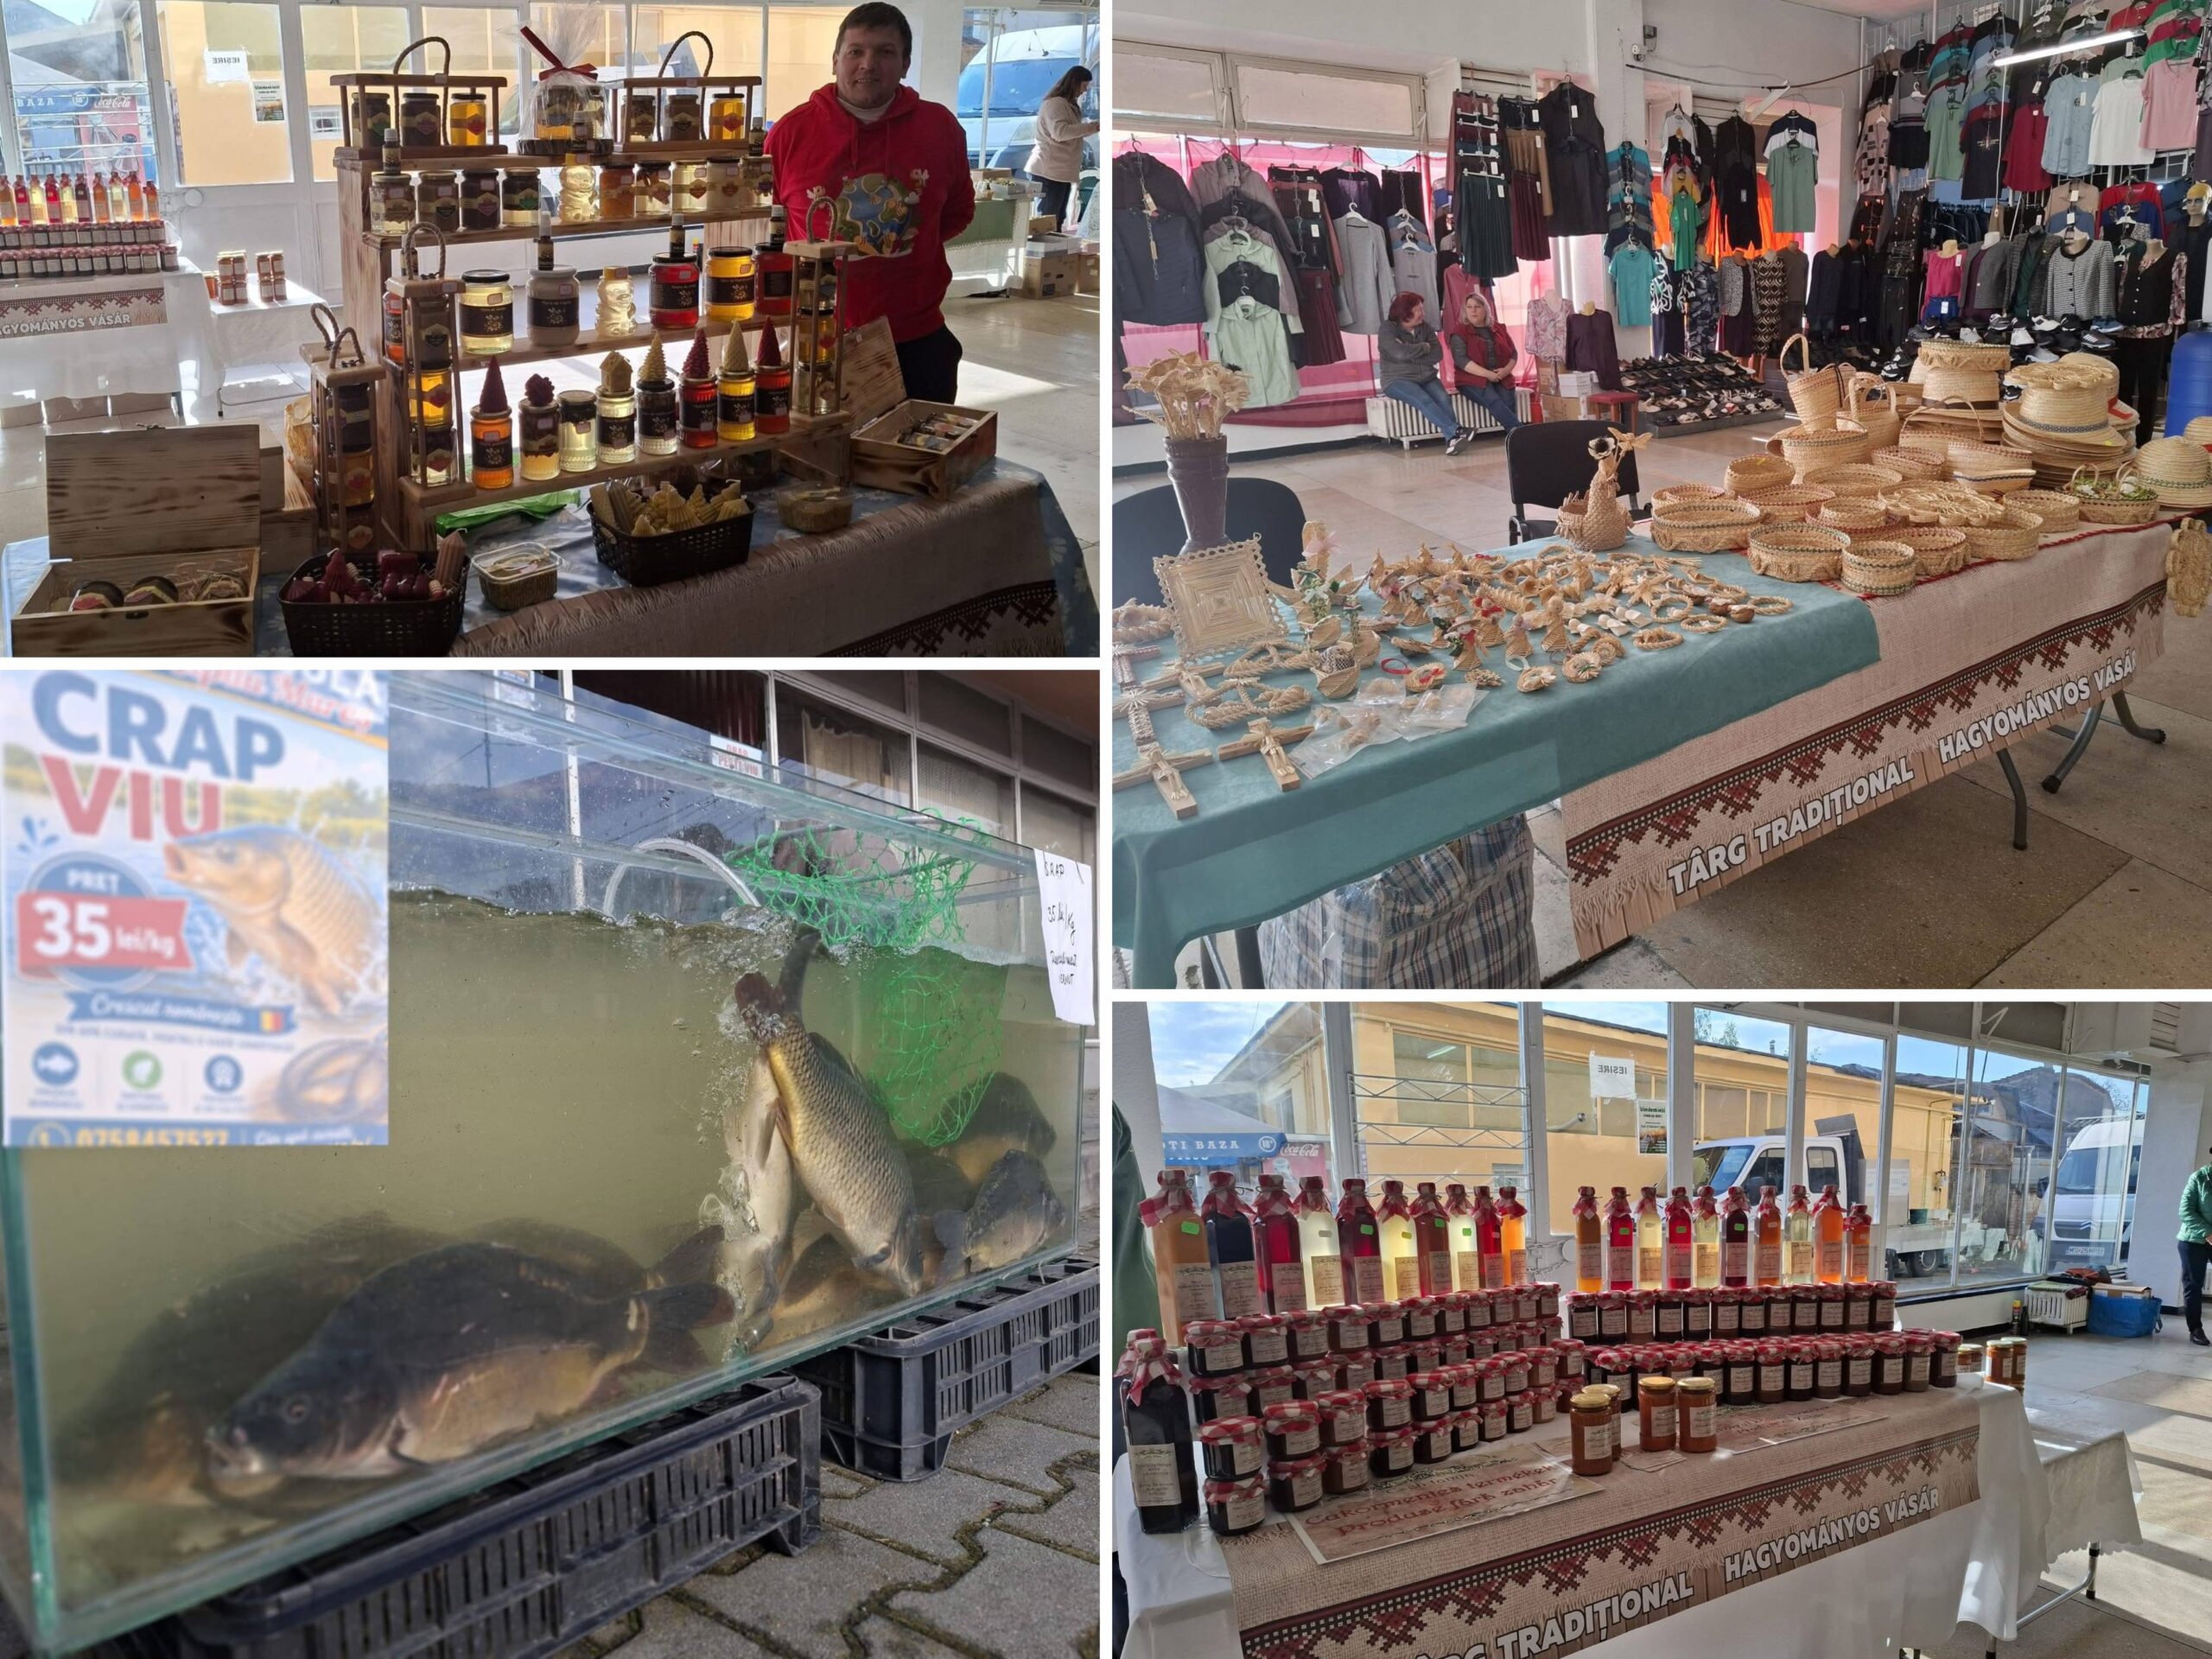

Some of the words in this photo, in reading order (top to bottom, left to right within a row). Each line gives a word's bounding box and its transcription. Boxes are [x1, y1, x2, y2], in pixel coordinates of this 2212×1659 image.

[89, 311, 130, 327] VÁSÁR
[33, 670, 284, 781] CRAP
[41, 753, 221, 842] VIU
[1667, 835, 1746, 896] TÂRG
[1754, 757, 1914, 854] TRADIȚIONAL
[1938, 676, 2090, 764] HAGYOMÁNYOS
[33, 897, 111, 959] 35
[1047, 905, 1057, 923] 35
[1196, 1141, 1239, 1150] BAZA
[1495, 1572, 1694, 1659] TRADIȚIONAL
[1725, 1506, 1880, 1582] HAGYOMÁNYOS
[1885, 1485, 1939, 1524] VÁSÁR
